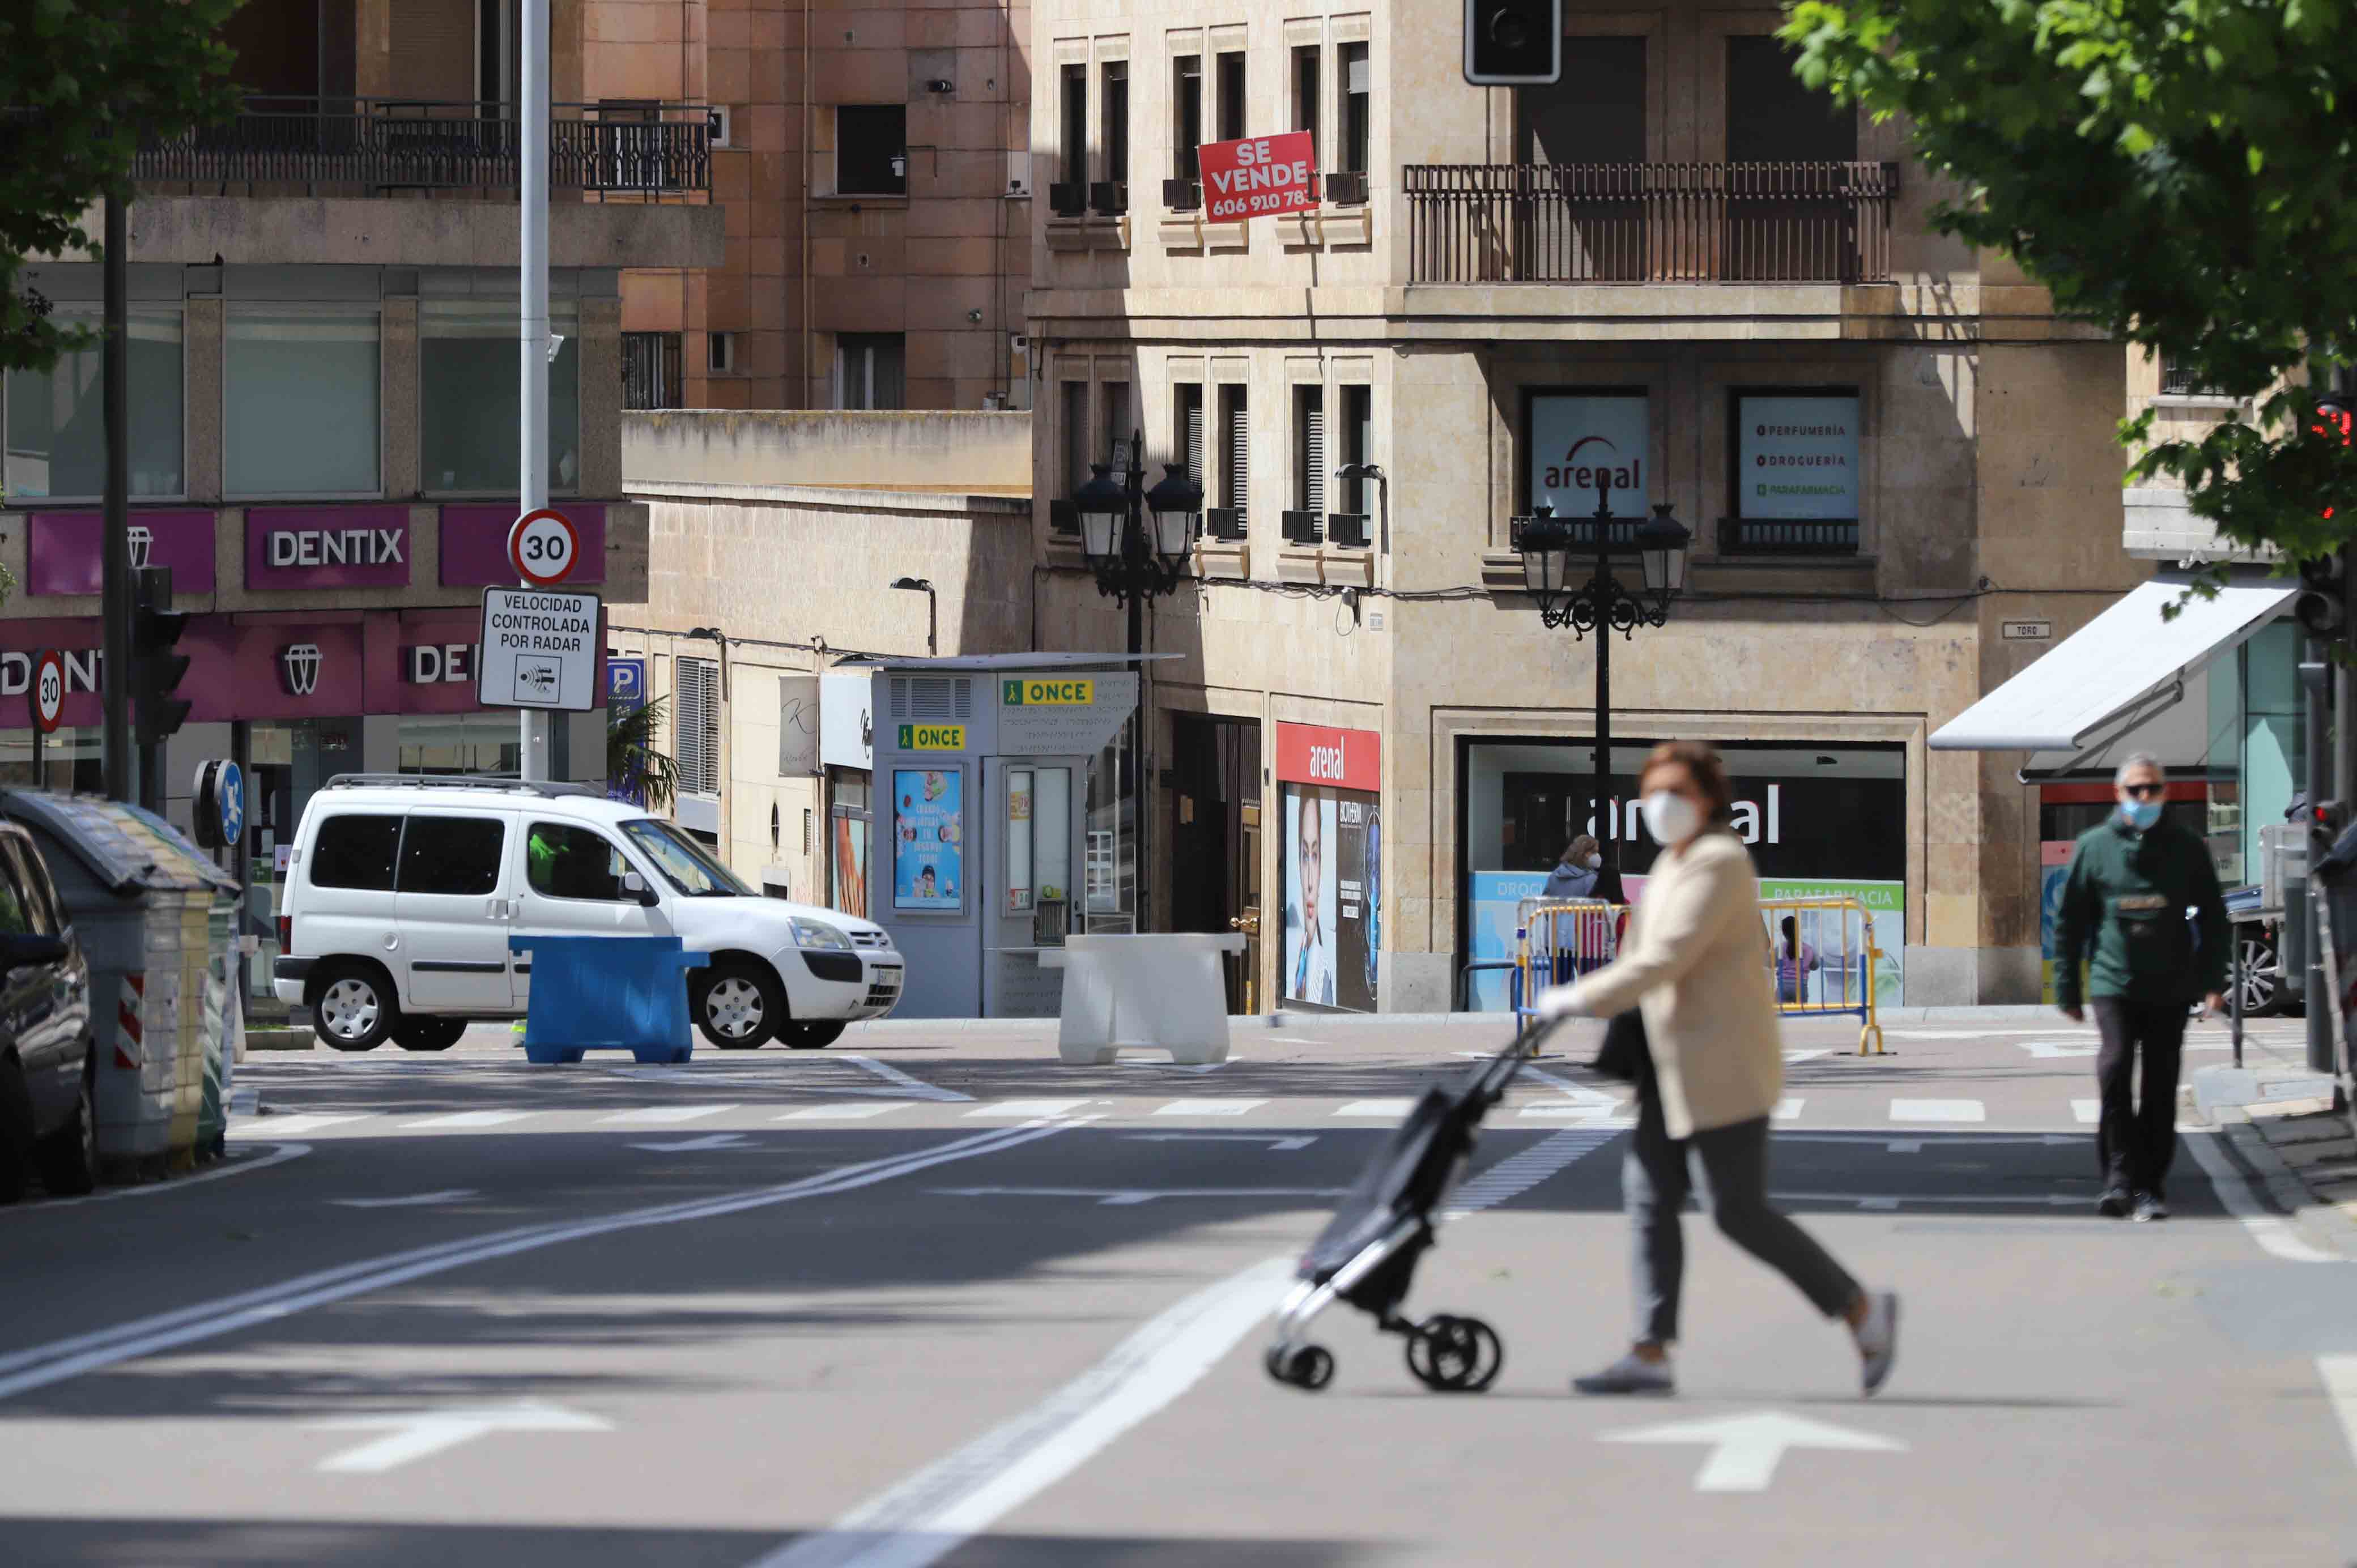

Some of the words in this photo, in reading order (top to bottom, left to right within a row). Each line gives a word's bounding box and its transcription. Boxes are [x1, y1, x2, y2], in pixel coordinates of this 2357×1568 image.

[1236, 140, 1271, 166] SE
[1211, 161, 1308, 194] VENDE
[1213, 198, 1246, 216] 606
[1250, 194, 1280, 211] 910
[1283, 189, 1314, 207] 78
[1544, 459, 1639, 488] arenal
[273, 529, 403, 566] DENTIX
[526, 535, 565, 560] 30
[504, 595, 582, 612] VELOCIDAD
[492, 613, 590, 633] CONTROLADA
[2016, 625, 2037, 635] TORO
[501, 633, 529, 649] POR
[533, 636, 581, 651] RADAR
[415, 644, 480, 683] DE
[42, 676, 58, 704] 30
[1031, 684, 1086, 701] ONCE
[918, 728, 960, 747] ONCE
[1310, 735, 1344, 780] arenal
